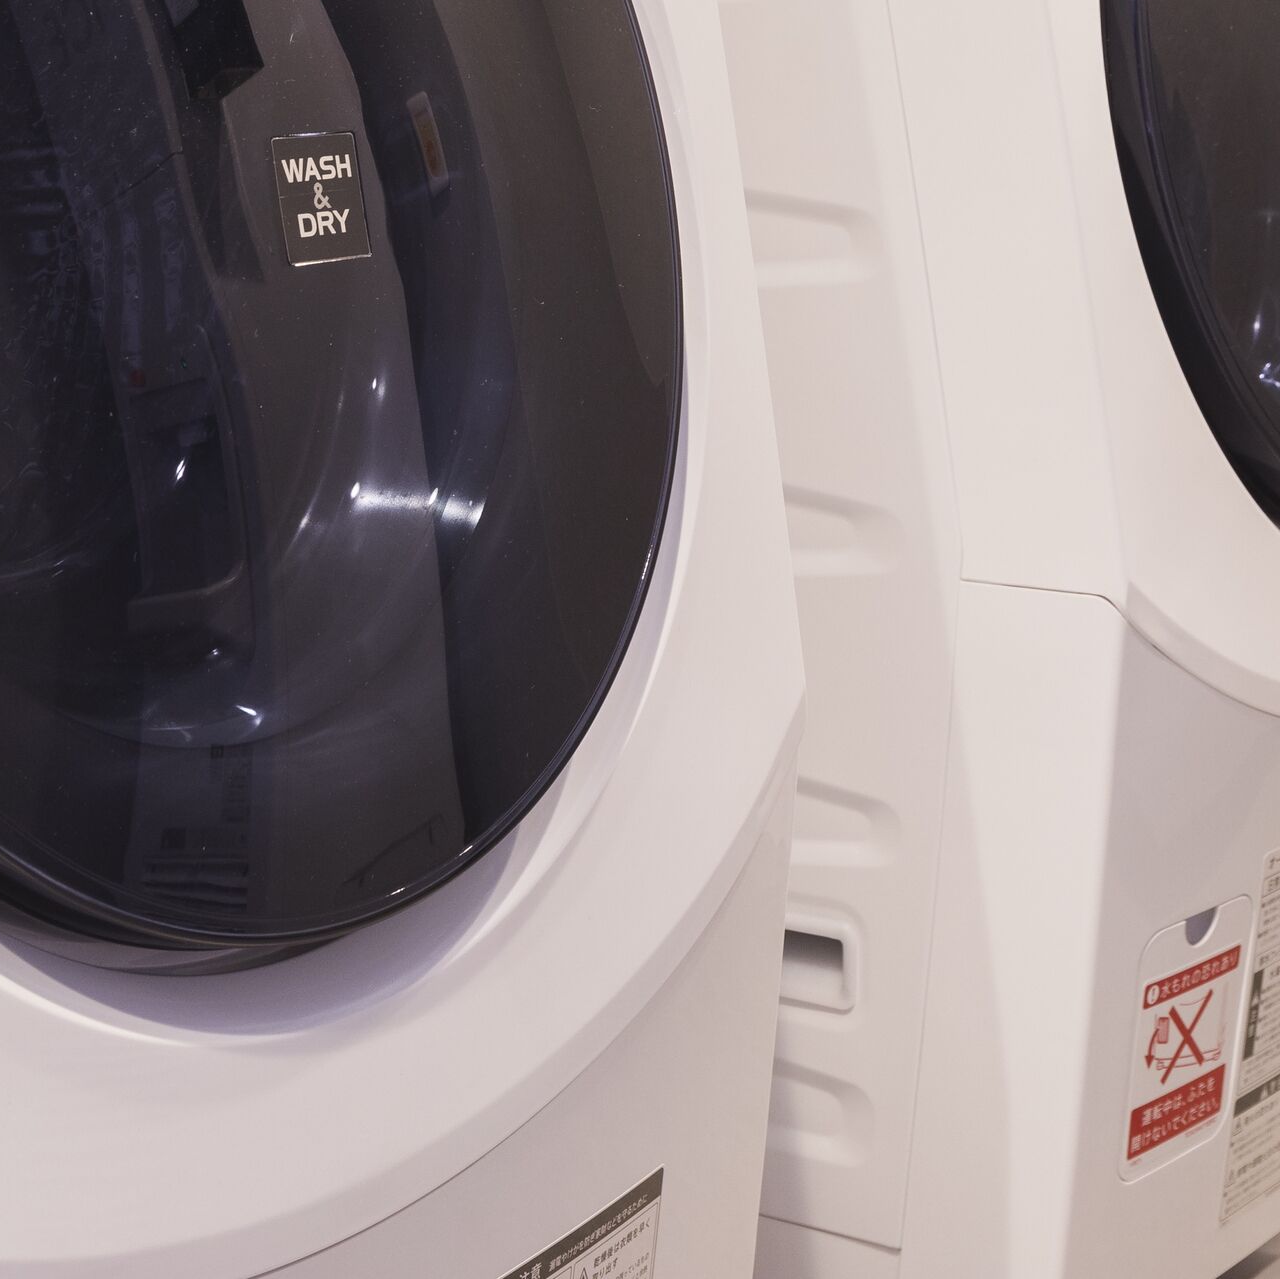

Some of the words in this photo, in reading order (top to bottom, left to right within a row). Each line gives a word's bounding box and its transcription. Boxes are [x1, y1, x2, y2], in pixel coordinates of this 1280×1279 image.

[281, 154, 352, 184] WASH
[314, 182, 332, 210] &
[297, 209, 350, 238] DRY
